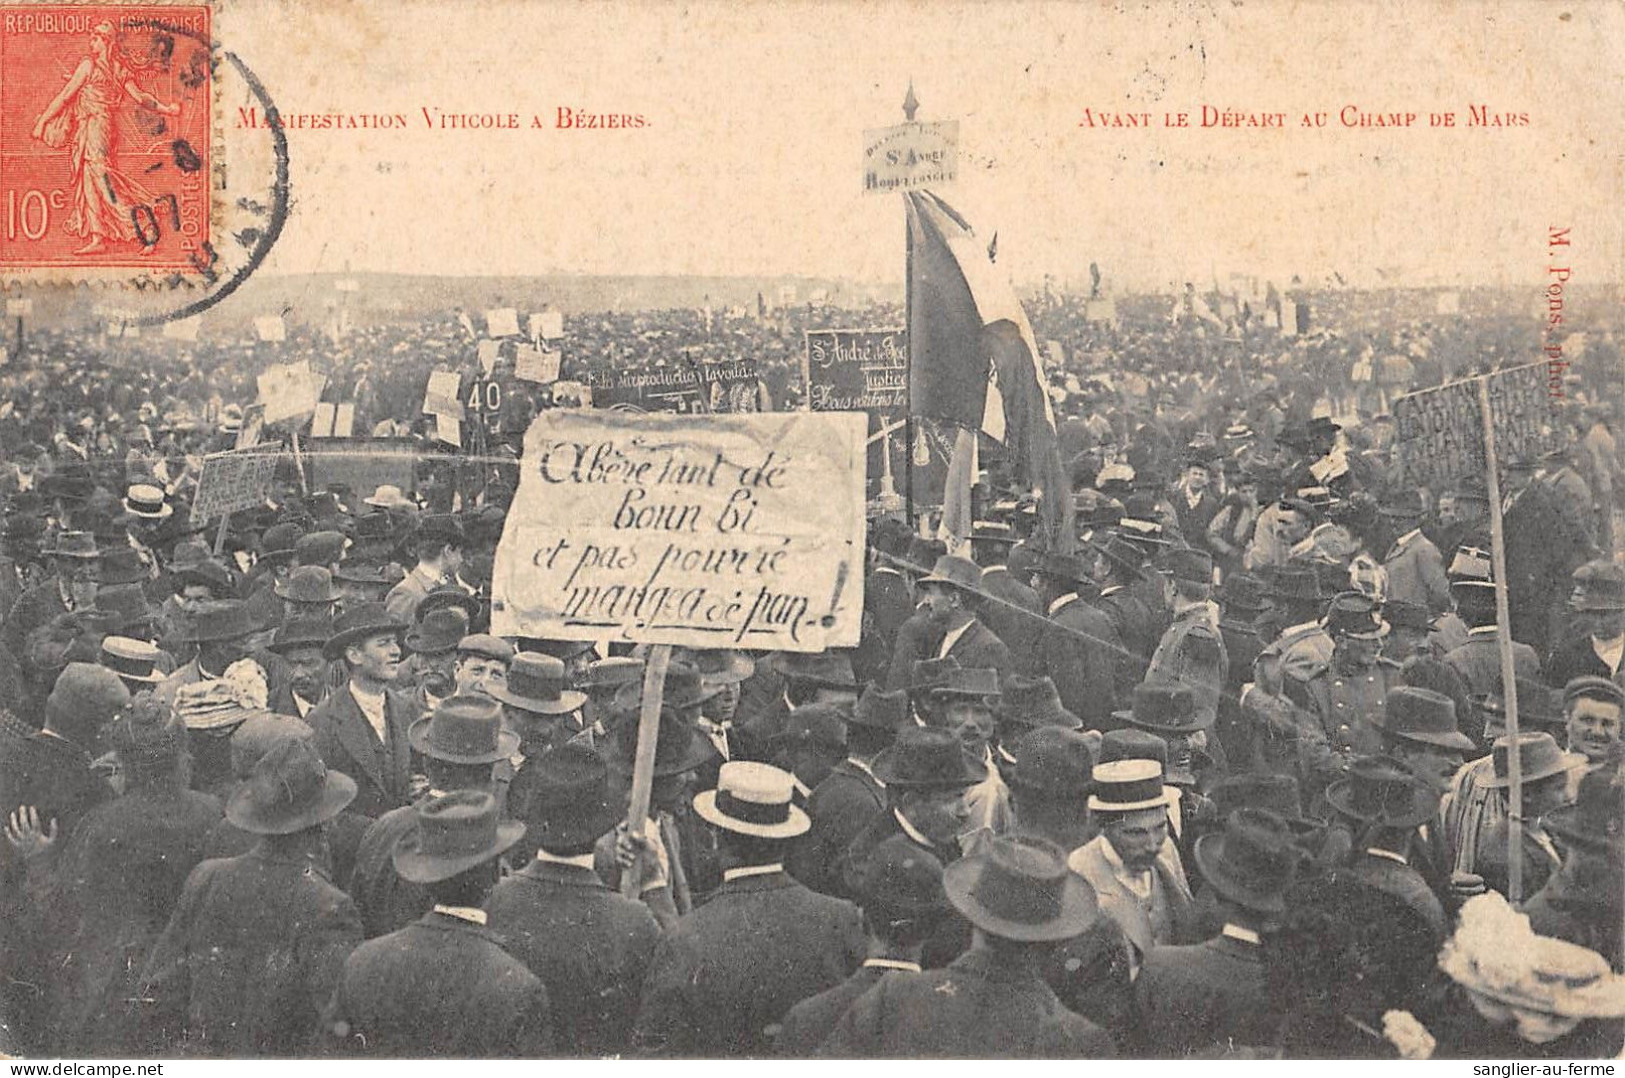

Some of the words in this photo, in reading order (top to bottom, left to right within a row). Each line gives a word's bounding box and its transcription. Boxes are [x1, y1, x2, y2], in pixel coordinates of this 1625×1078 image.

[467, 382, 500, 411] 40
[533, 538, 570, 569] et
[562, 545, 638, 591] pas
